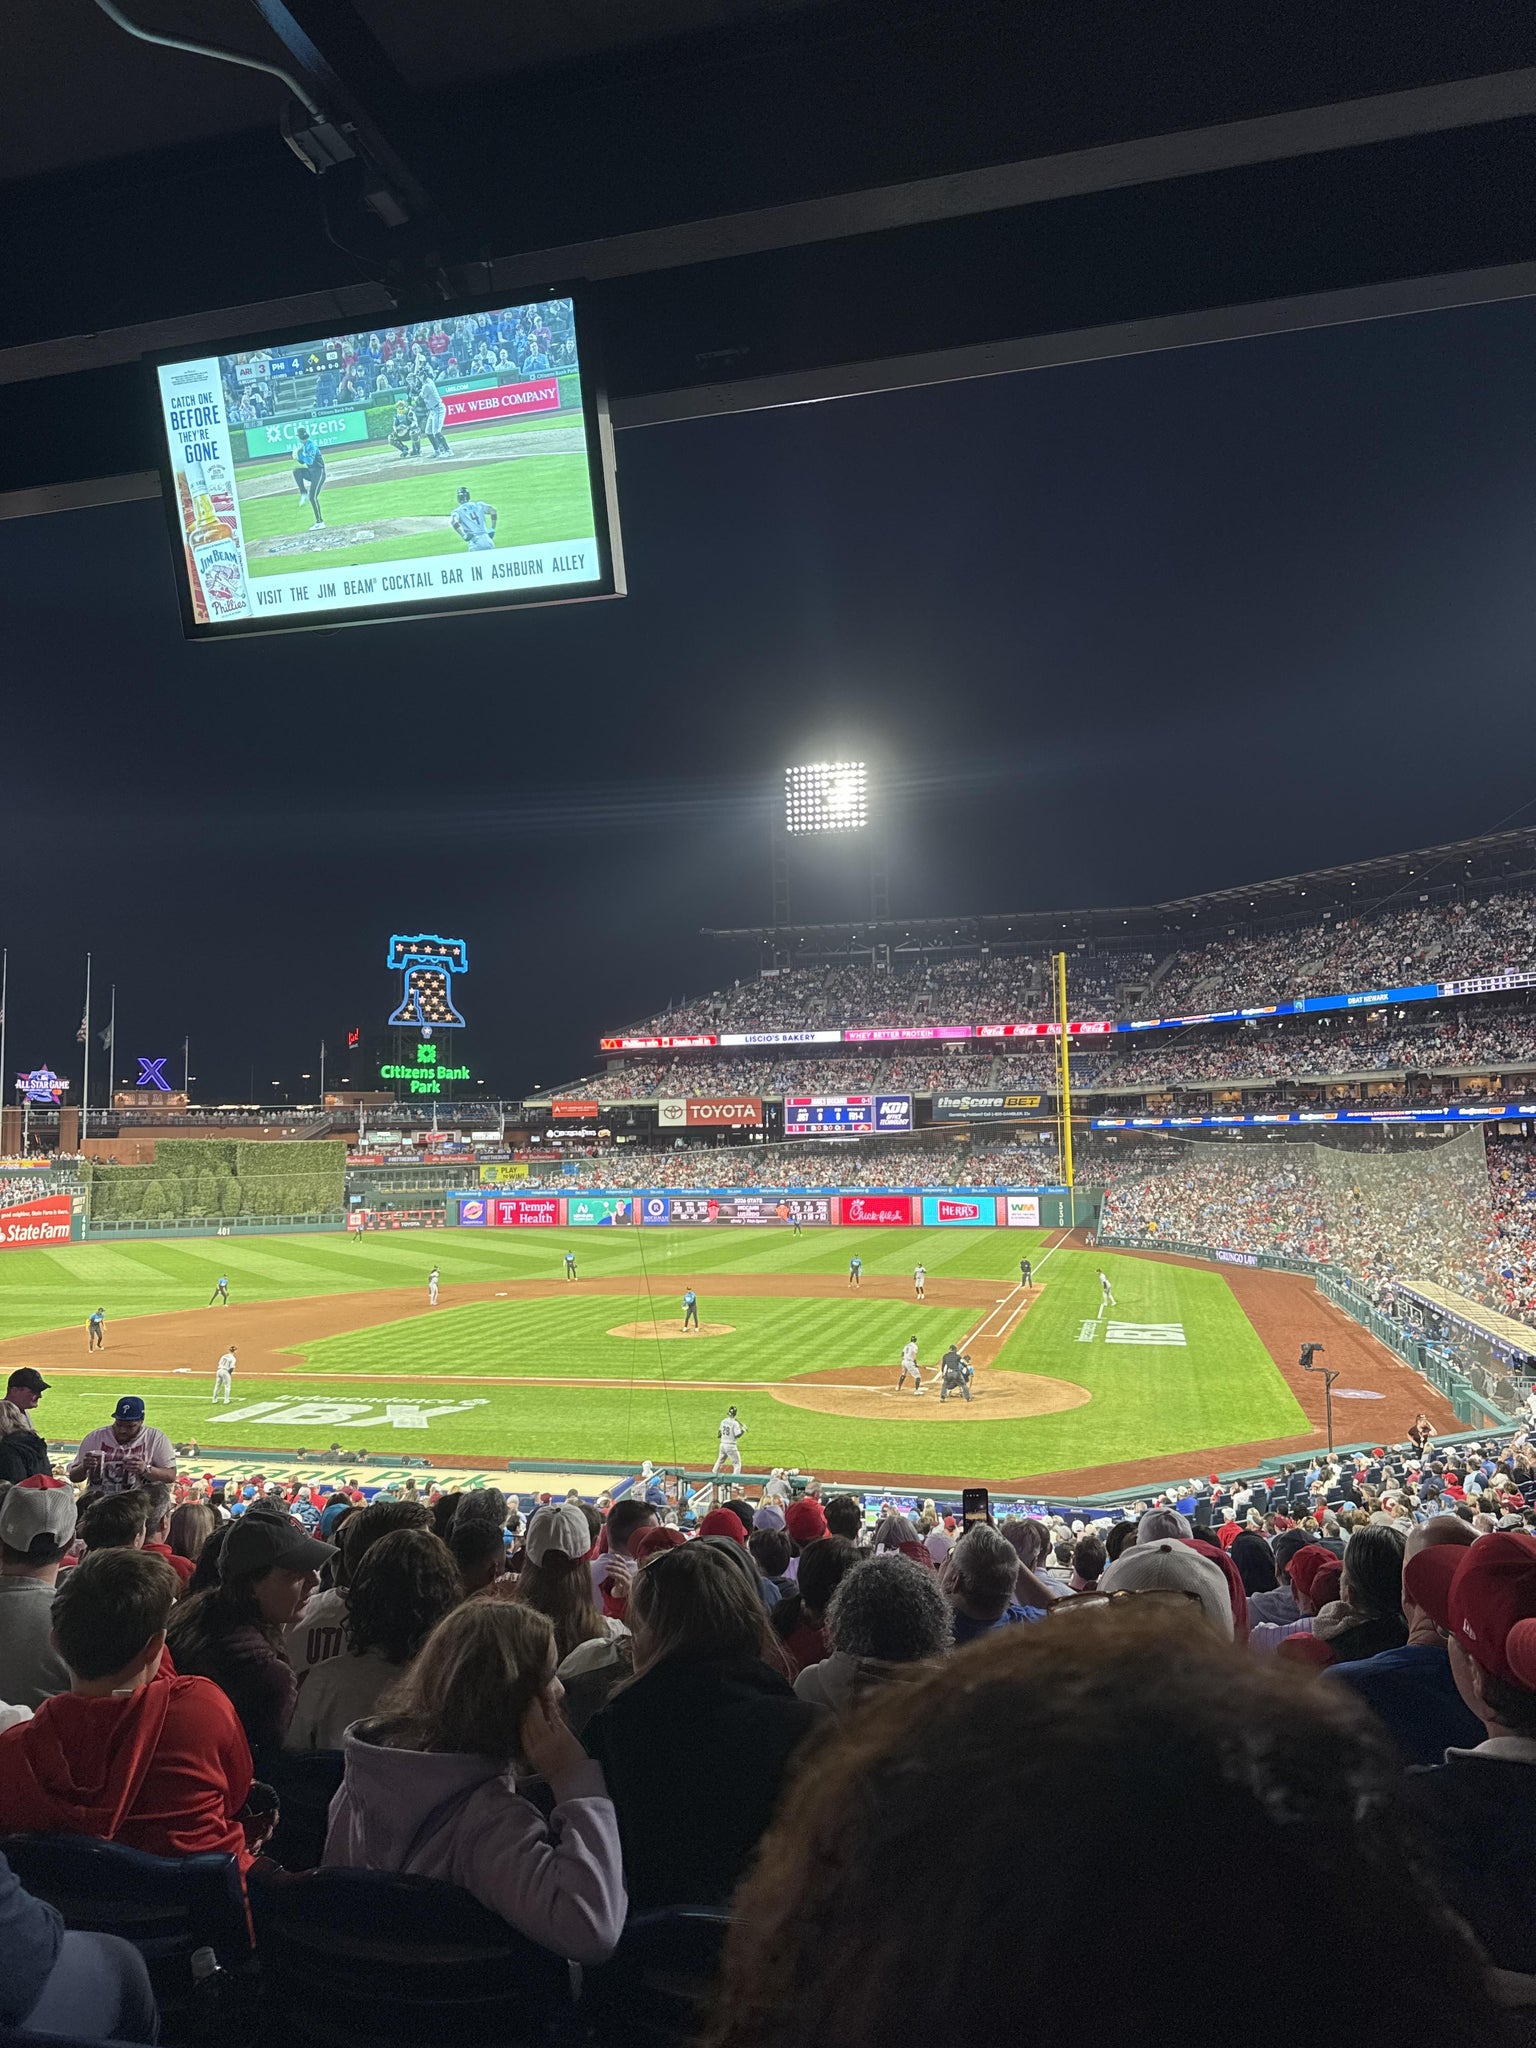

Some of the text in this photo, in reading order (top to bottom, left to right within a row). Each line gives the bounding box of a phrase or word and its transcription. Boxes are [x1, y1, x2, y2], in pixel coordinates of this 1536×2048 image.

[240, 364, 266, 376] ARI 3
[272, 358, 299, 371] PHI 4
[171, 392, 214, 409] CATCH ONE
[448, 388, 556, 415] F.W. WEBB COMPANY
[170, 405, 220, 430] BEFORE
[178, 428, 210, 444] THEY'RE
[184, 441, 220, 464] GONE
[469, 512, 480, 525] 4
[200, 549, 238, 574] JIM BEAM
[256, 589, 282, 606] VISIT
[290, 586, 309, 602] THE
[317, 583, 336, 599] JIM
[382, 572, 434, 591] COCKTAIL
[441, 568, 464, 584] BAR
[472, 566, 483, 581] IN
[492, 559, 543, 579] ASHBURN
[552, 554, 585, 572] ALLEY
[212, 600, 246, 615] Phillies
[1363, 994, 1388, 1003] NEWARK
[782, 1033, 816, 1041] BAKERY
[381, 1065, 470, 1080] Citizens Bank
[15, 1079, 69, 1089] ALL STAR GAME
[410, 1080, 440, 1093] Park
[938, 1096, 1037, 1108] theScore BET
[690, 1104, 756, 1118] TOYOTA
[519, 1202, 555, 1213] Temple
[850, 1204, 902, 1222] Chick-fil-A
[942, 1205, 974, 1216] HERR'S
[520, 1213, 553, 1223] Health
[217, 1227, 230, 1236] 401
[274, 1395, 454, 1404] Independence
[205, 1402, 474, 1428] IBX
[223, 1465, 356, 1481] Bank
[365, 1471, 503, 1489] Park
